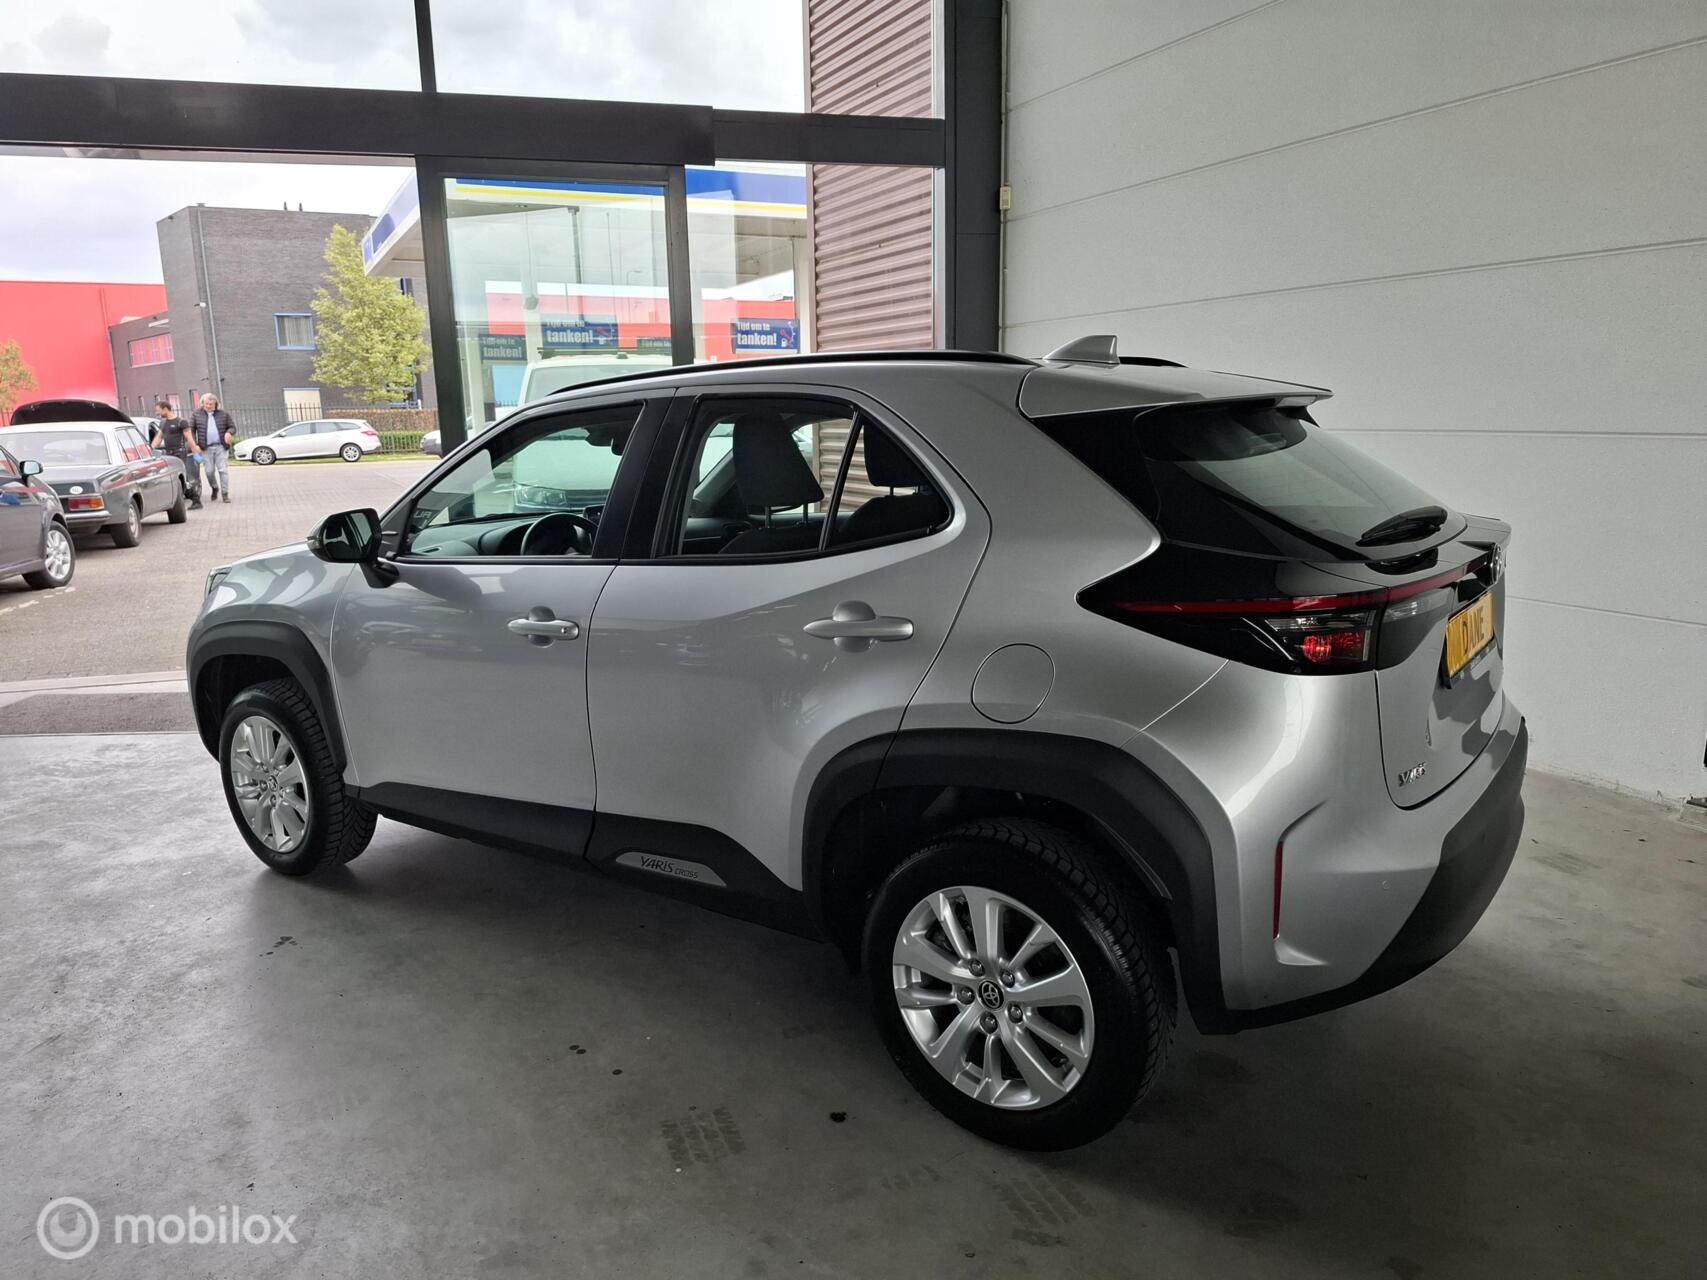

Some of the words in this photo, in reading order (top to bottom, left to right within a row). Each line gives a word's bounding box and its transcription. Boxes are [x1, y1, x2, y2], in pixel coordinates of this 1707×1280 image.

[737, 322, 750, 331] Tijd
[762, 322, 770, 331] te
[546, 329, 594, 343] tanken!
[737, 333, 777, 345] tanken!
[483, 346, 522, 358] tanken!
[641, 856, 674, 872] YARIS
[674, 868, 698, 879] CROSS
